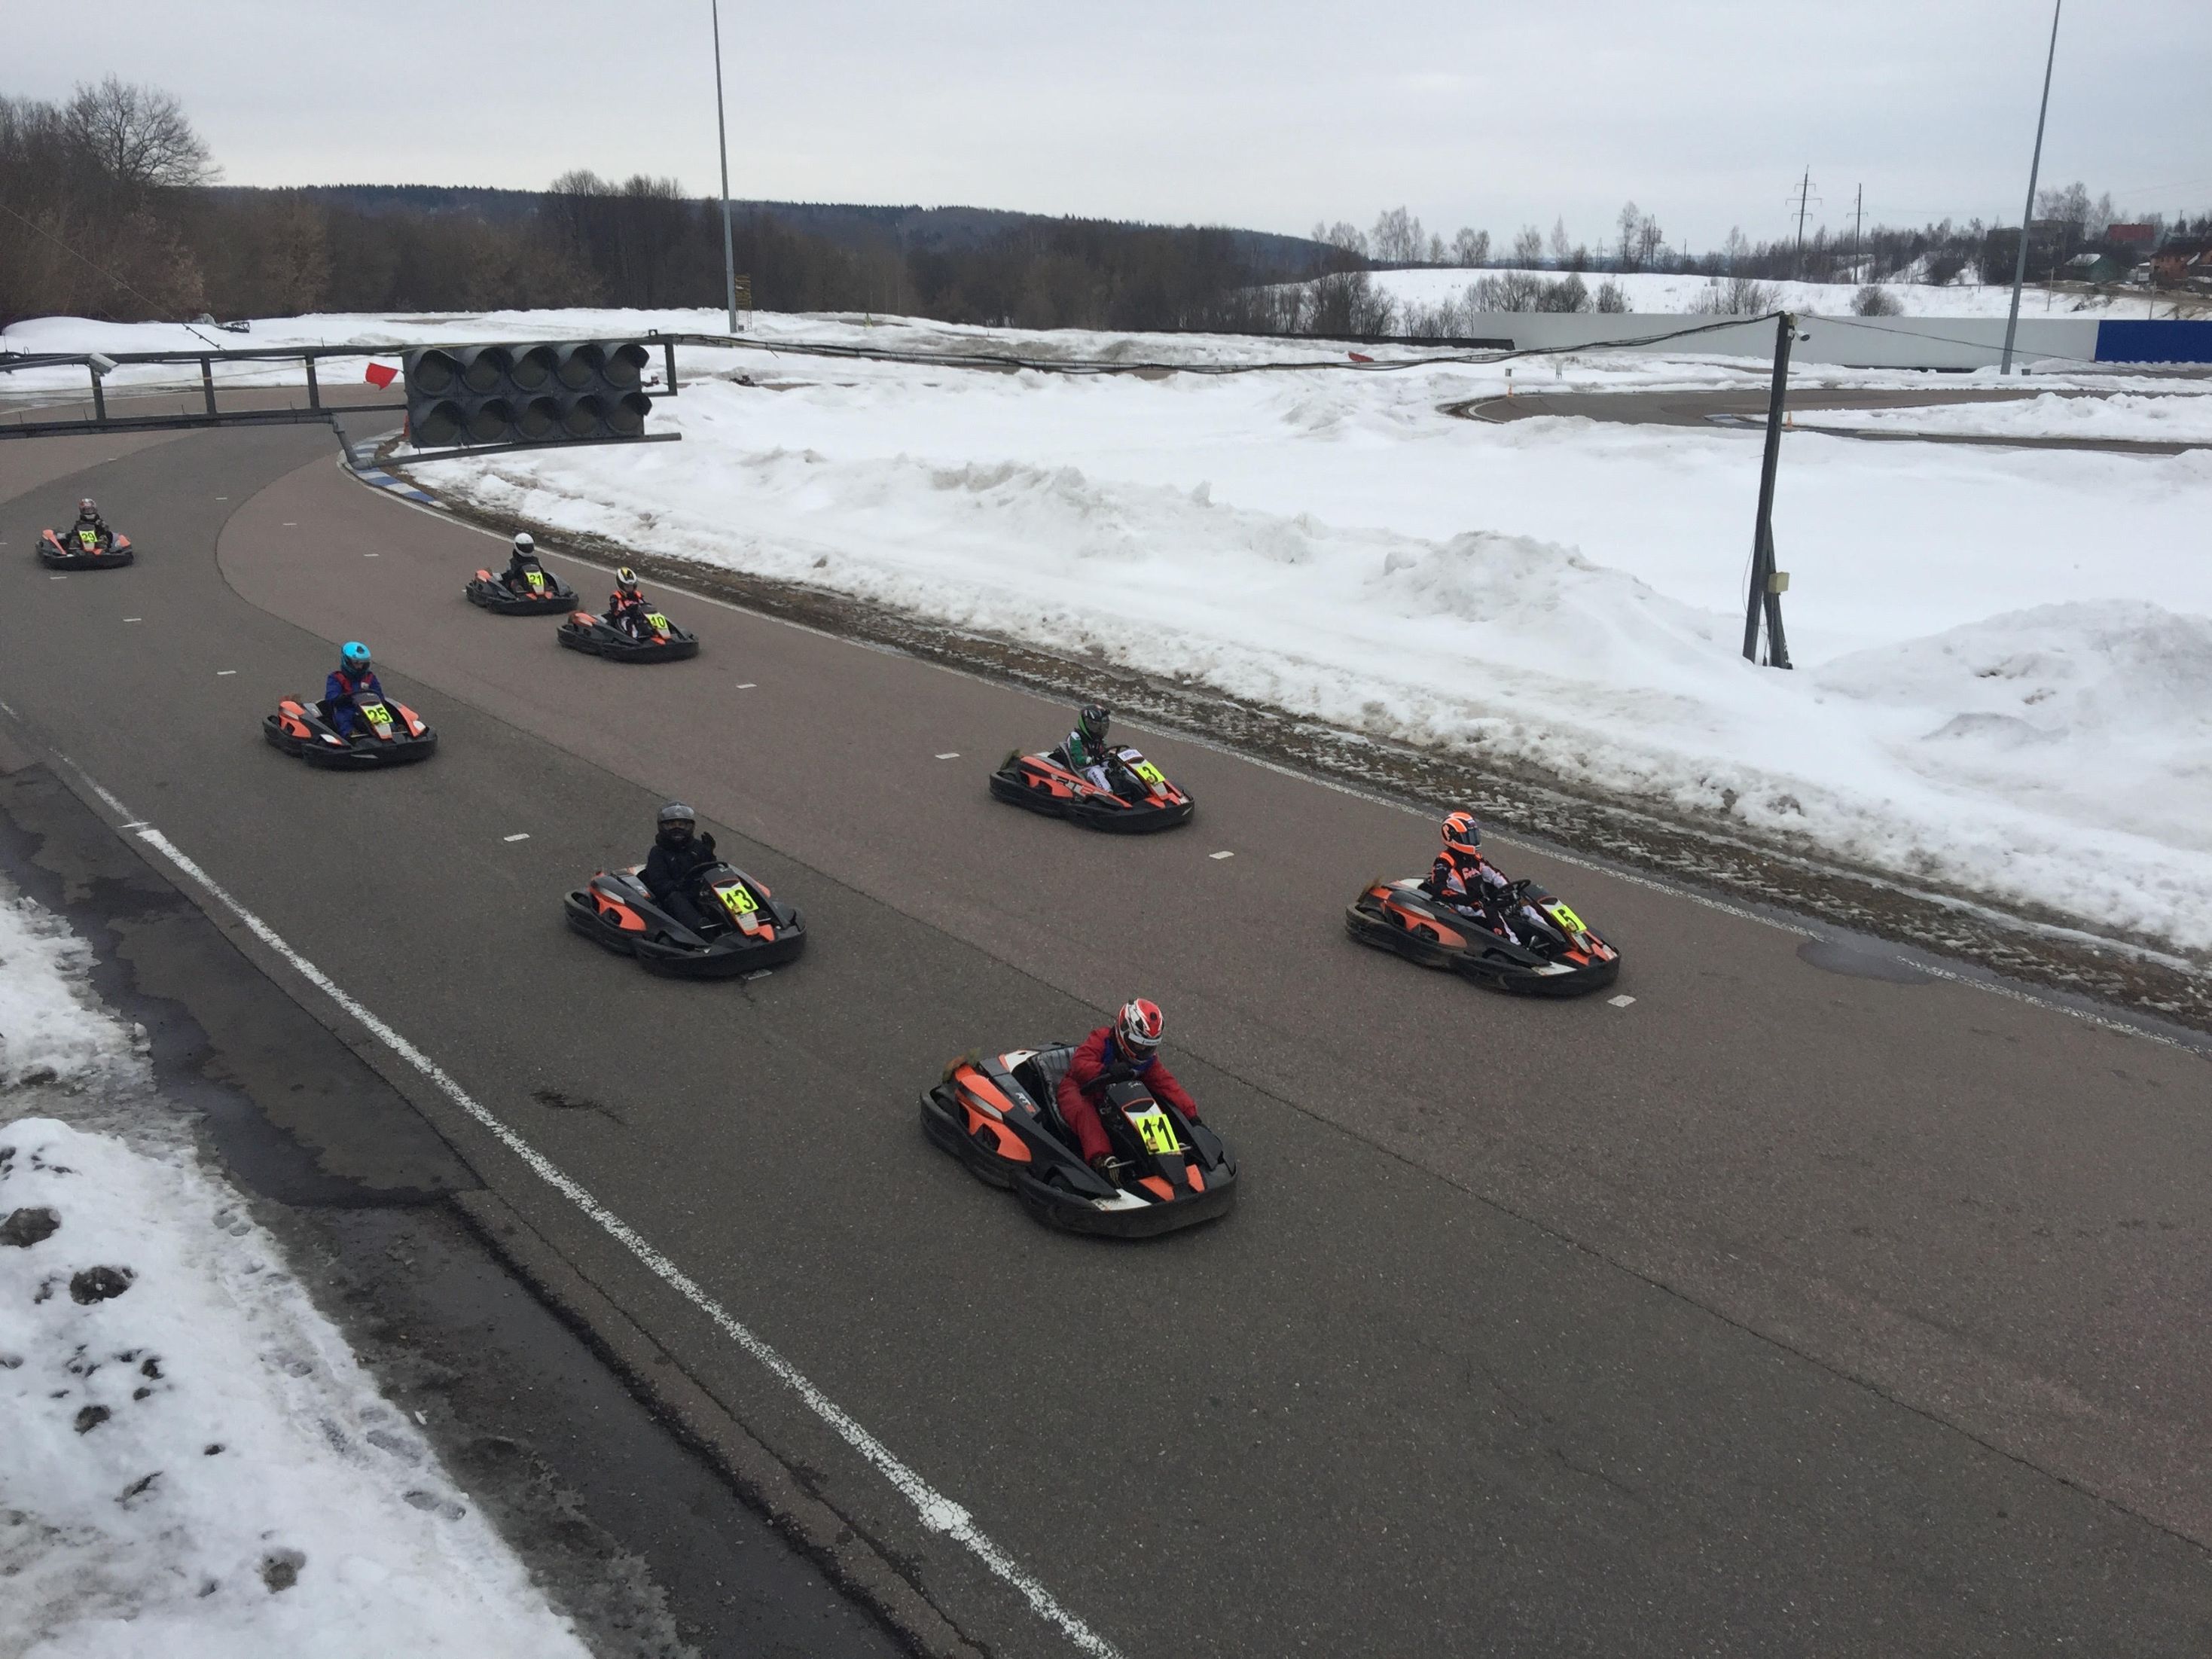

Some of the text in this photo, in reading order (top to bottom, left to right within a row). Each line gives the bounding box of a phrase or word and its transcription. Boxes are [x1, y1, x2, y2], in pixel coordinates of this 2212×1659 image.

[529, 575, 542, 585] 21
[651, 616, 665, 628] 10
[368, 707, 389, 724] 25
[1142, 766, 1158, 784] 3
[726, 889, 754, 913] 13
[1557, 908, 1579, 932] 5
[1143, 1117, 1174, 1151] 11
